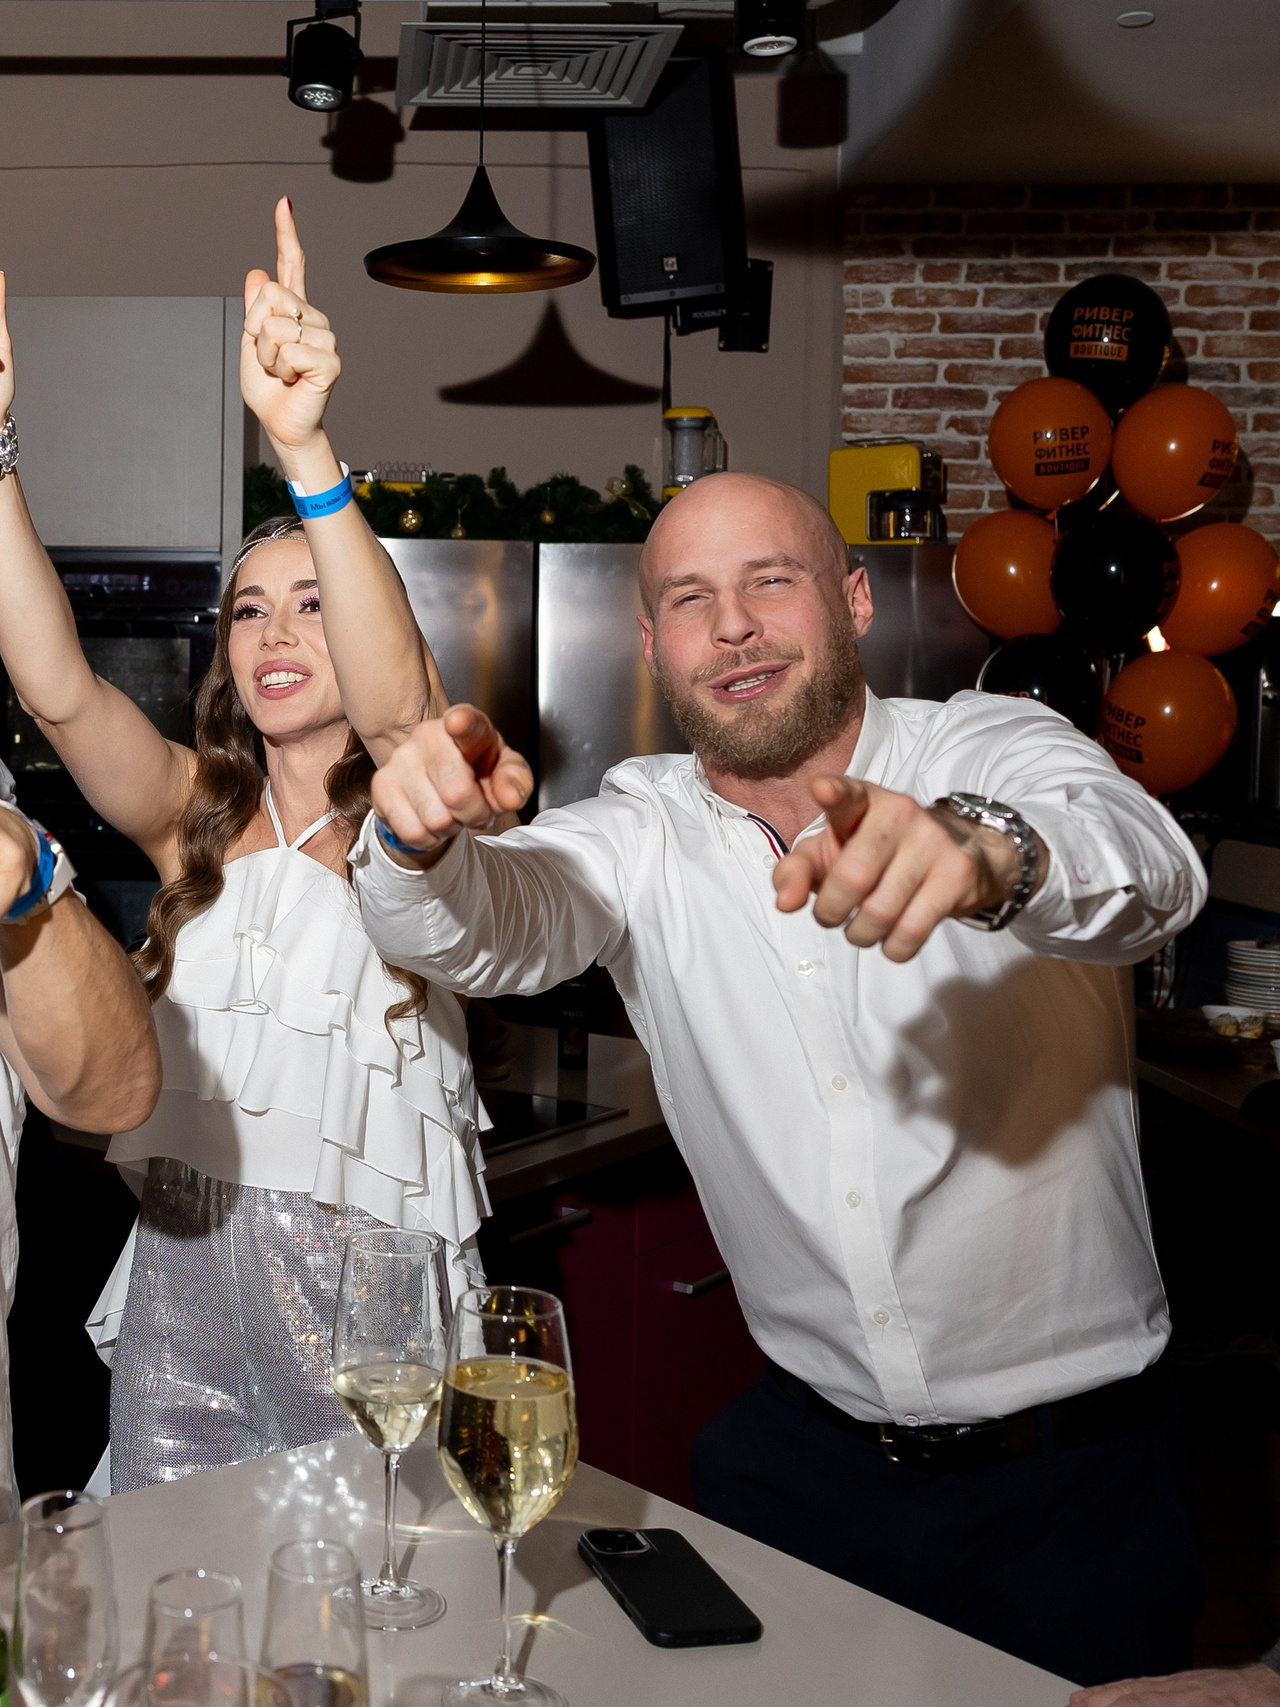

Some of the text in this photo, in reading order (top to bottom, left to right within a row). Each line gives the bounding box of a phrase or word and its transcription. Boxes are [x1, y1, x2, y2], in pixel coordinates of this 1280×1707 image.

[1073, 306, 1134, 323] РИВЕР
[1071, 323, 1131, 342] ФИТНЕС
[1074, 343, 1123, 357] BOUTIQUE
[1033, 426, 1089, 444] РИВЕР
[1035, 442, 1090, 459] ФИТНЕС
